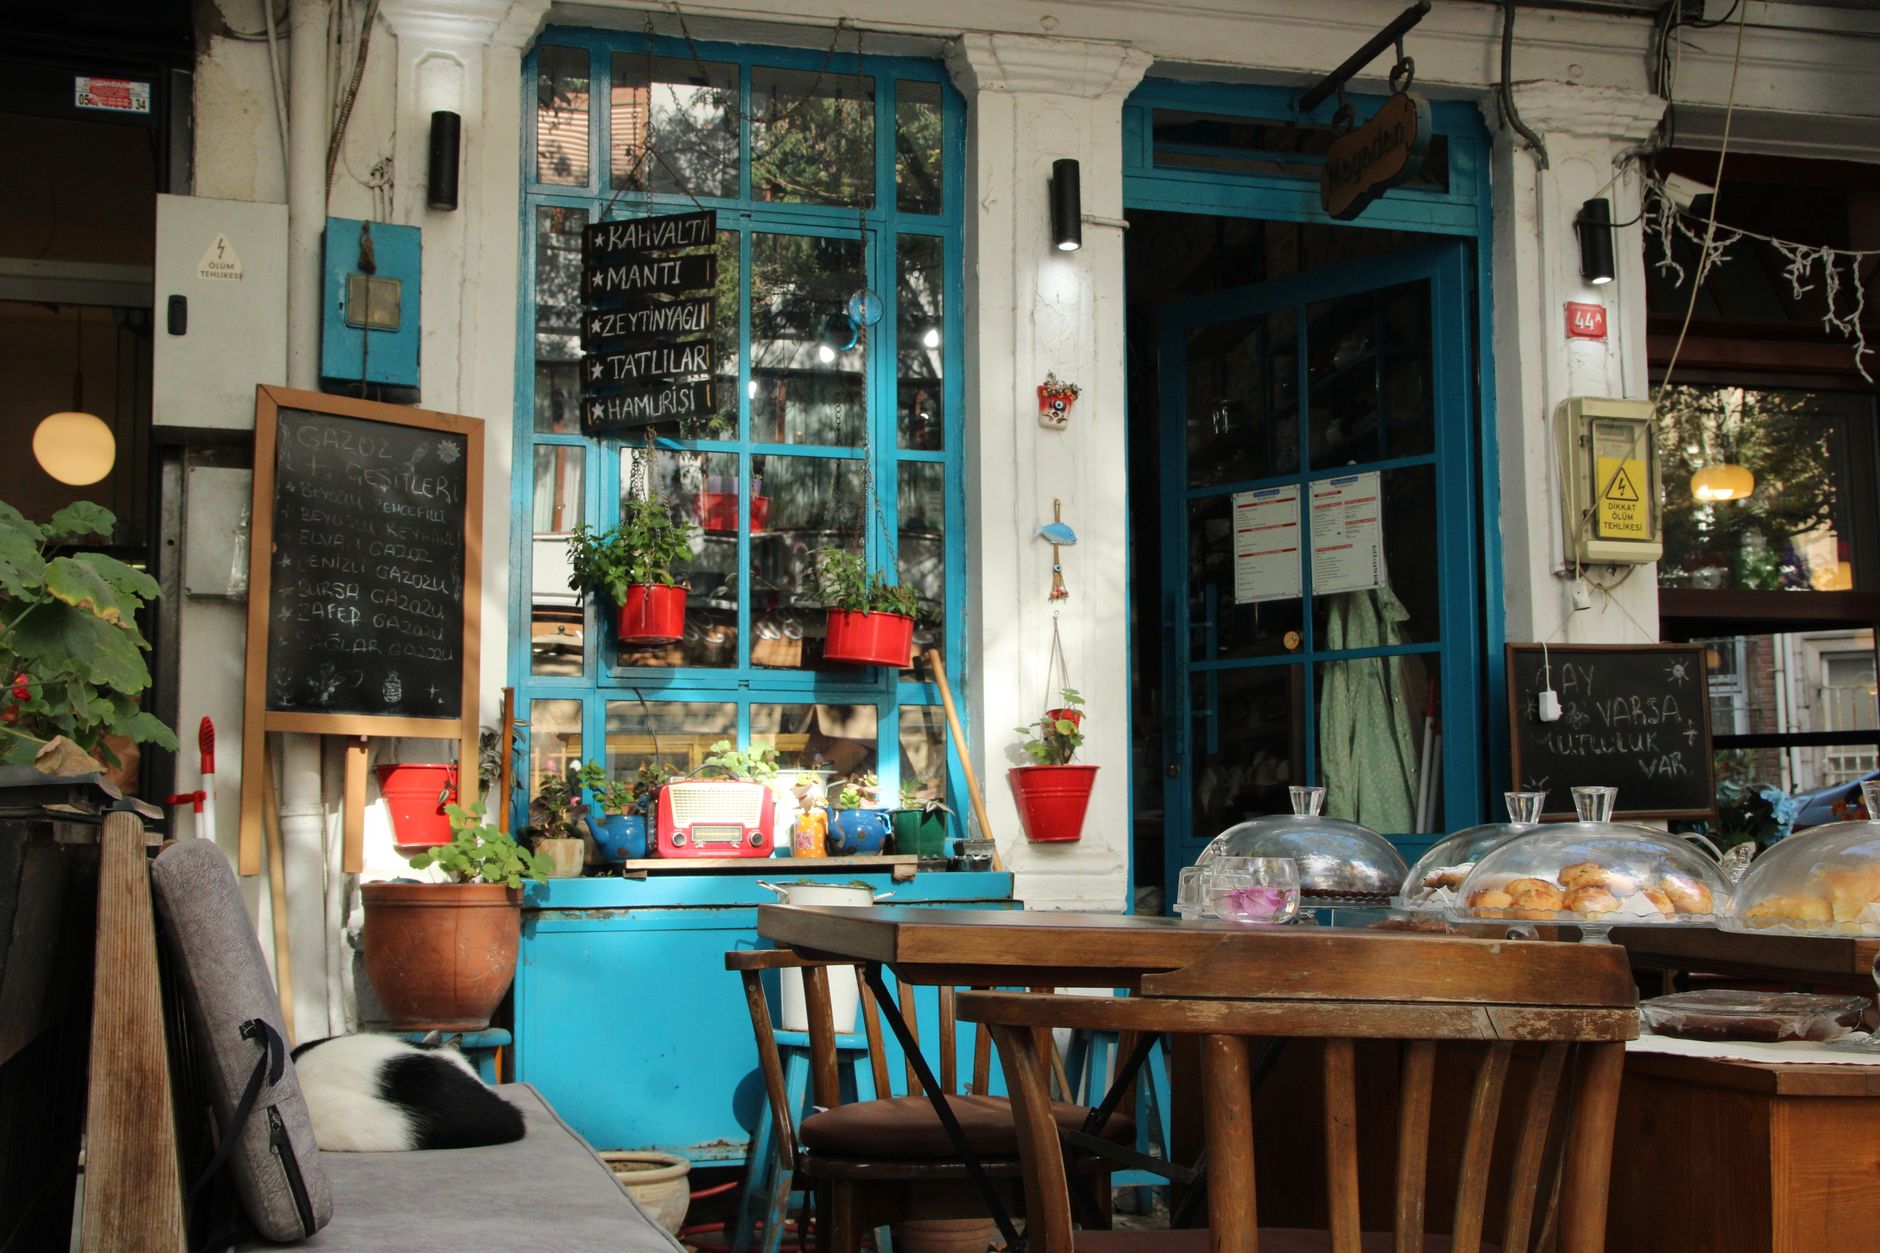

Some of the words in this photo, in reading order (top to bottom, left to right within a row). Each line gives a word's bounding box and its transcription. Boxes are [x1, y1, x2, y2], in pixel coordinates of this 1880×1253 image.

[607, 219, 707, 252] KAHVALTI
[606, 260, 682, 291] MANTI
[601, 302, 706, 337] ZEYTİNYAĞLI
[607, 345, 709, 380] TATLILAR
[607, 382, 696, 420] HAMURİŞİ
[297, 425, 392, 459] GAZOZ
[1607, 502, 1637, 512] DİKKAT
[1611, 511, 1634, 521] ÖLÜM
[1603, 521, 1643, 531] TEHLİKESİ
[1596, 695, 1683, 728] VARSA
[1638, 751, 1687, 780] VAR
